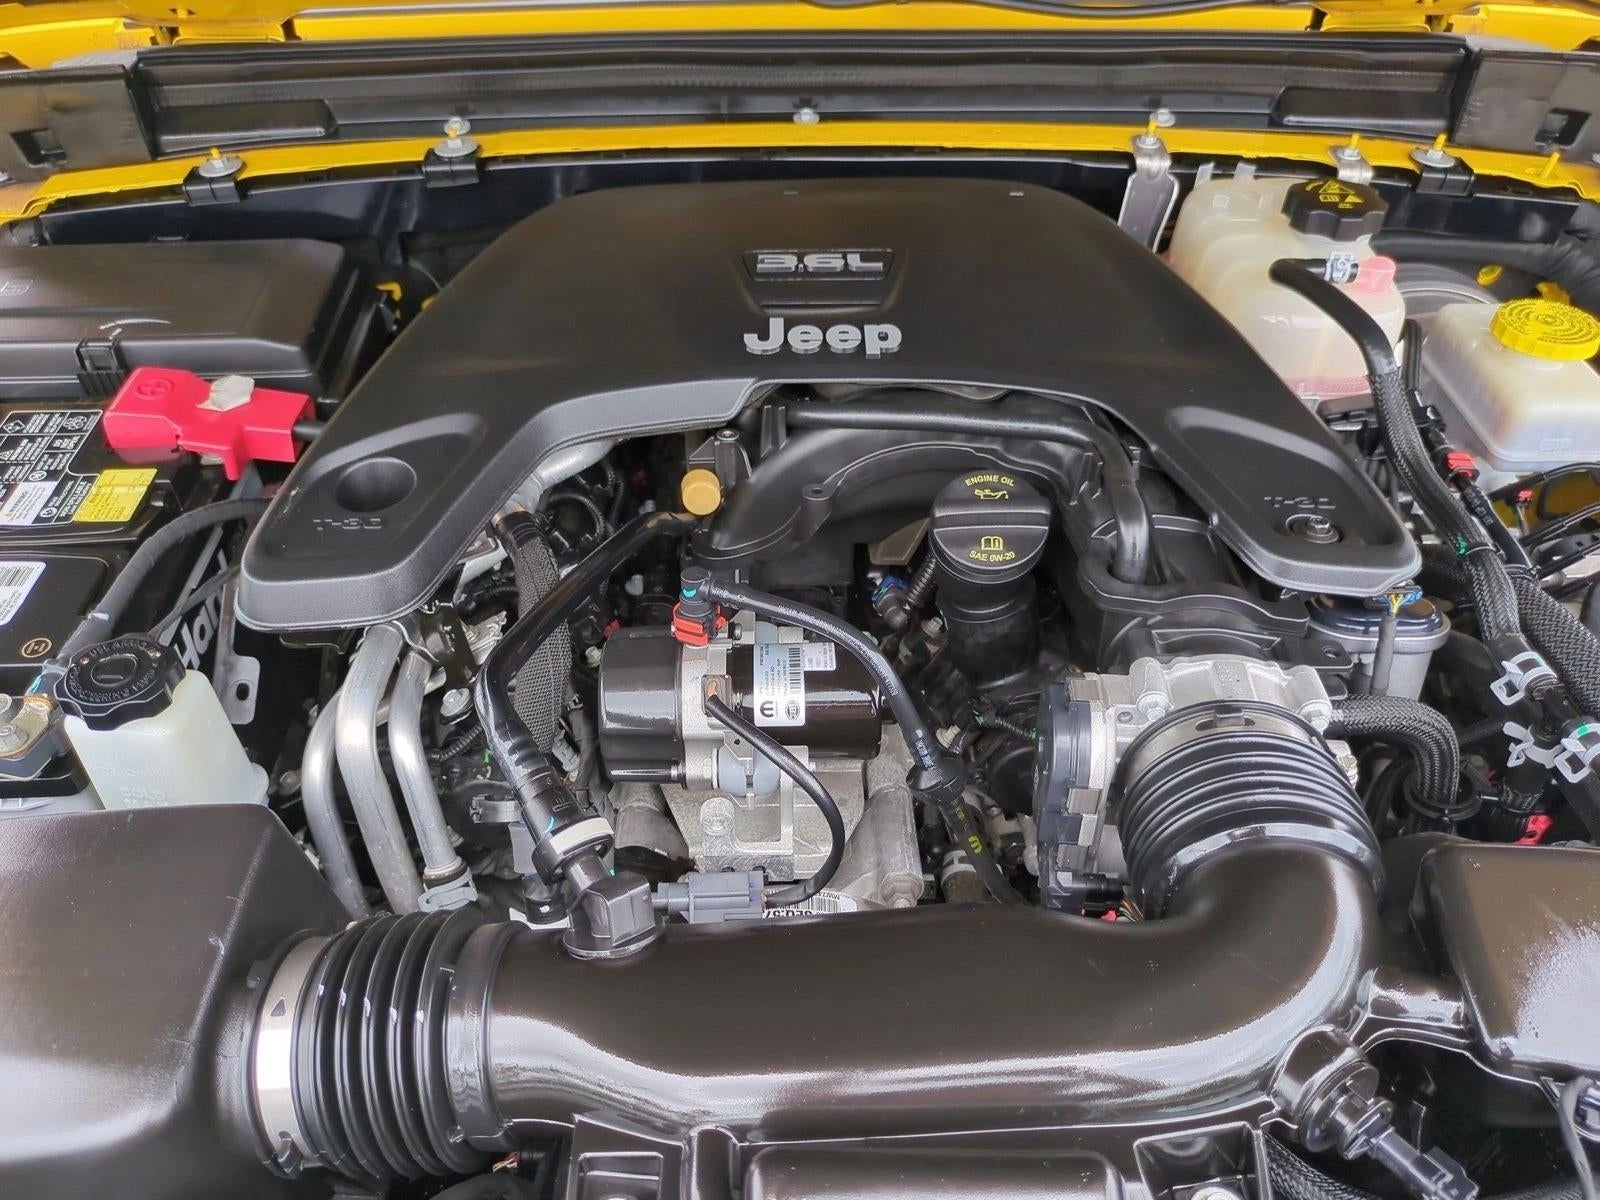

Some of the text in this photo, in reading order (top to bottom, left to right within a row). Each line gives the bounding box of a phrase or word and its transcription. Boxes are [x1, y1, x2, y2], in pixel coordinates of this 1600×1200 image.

[756, 253, 884, 273] 3.6L
[743, 317, 902, 359] Jeep
[964, 474, 1015, 487] ENGINE OIL
[969, 550, 988, 562] SAE
